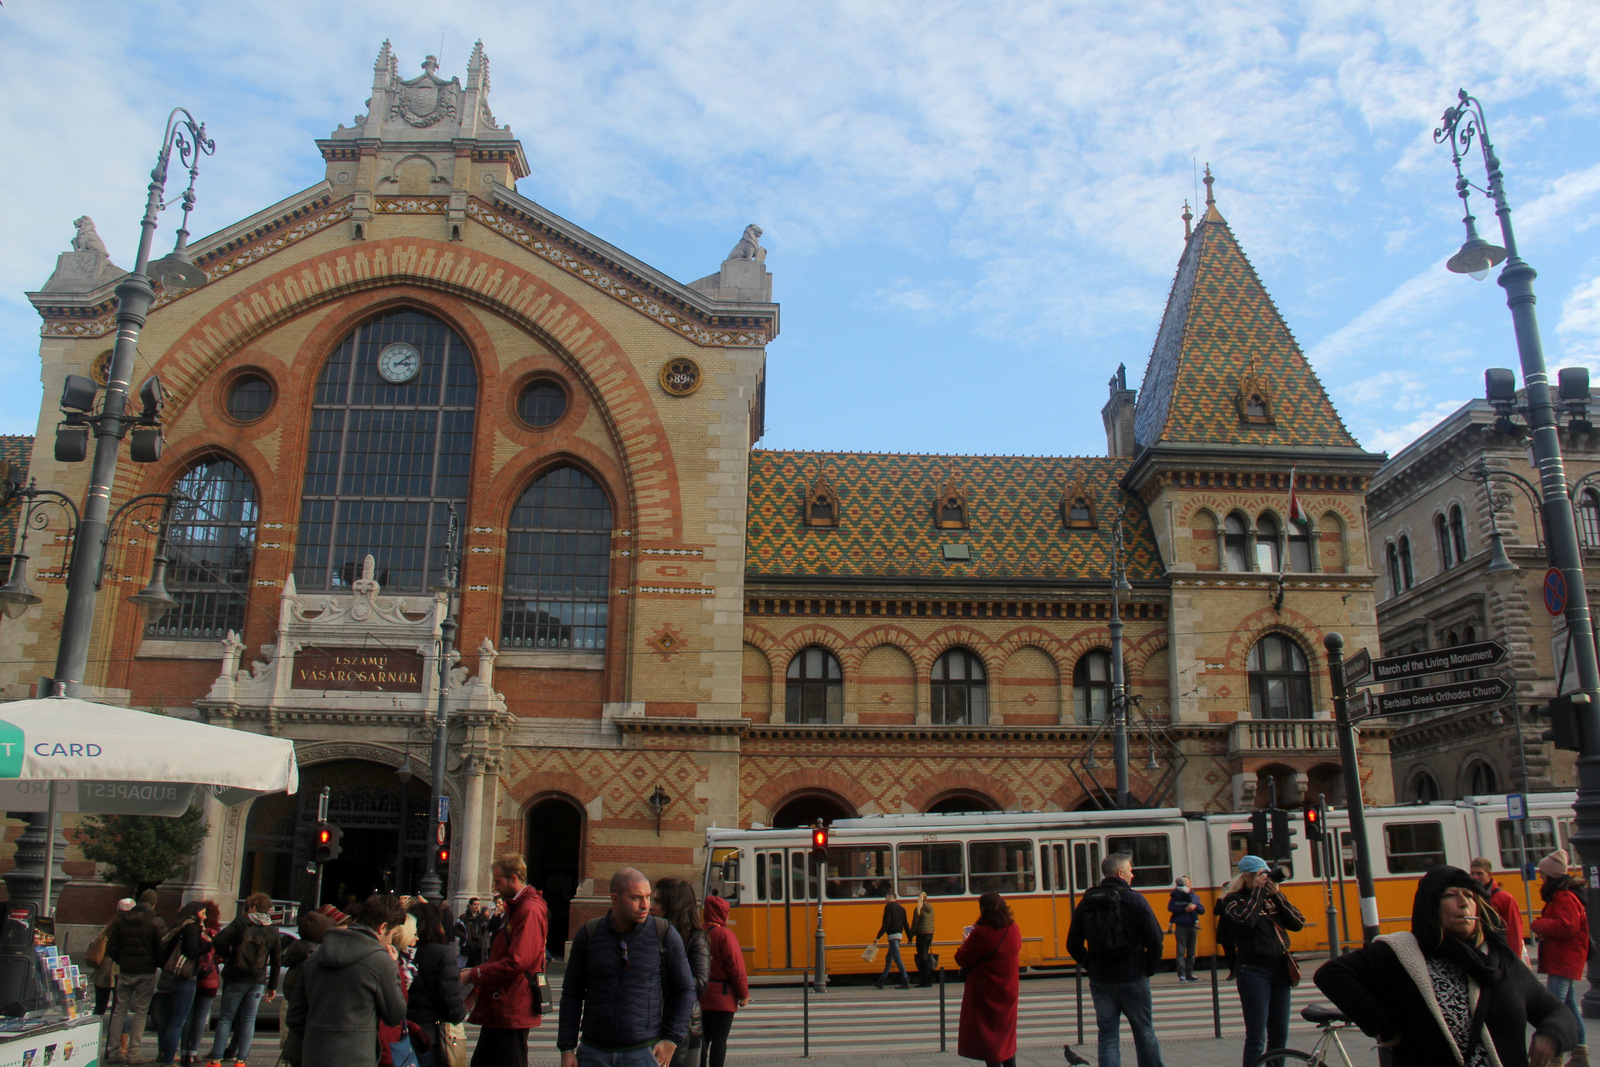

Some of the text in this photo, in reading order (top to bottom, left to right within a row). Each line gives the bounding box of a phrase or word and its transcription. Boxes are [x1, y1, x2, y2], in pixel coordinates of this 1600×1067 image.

[1378, 649, 1493, 676] March of the Living Monument
[300, 665, 417, 684] VÁSÁRCSARNOK
[1383, 685, 1501, 709] Serbian Greek Orthodox Church
[33, 742, 103, 757] CARD
